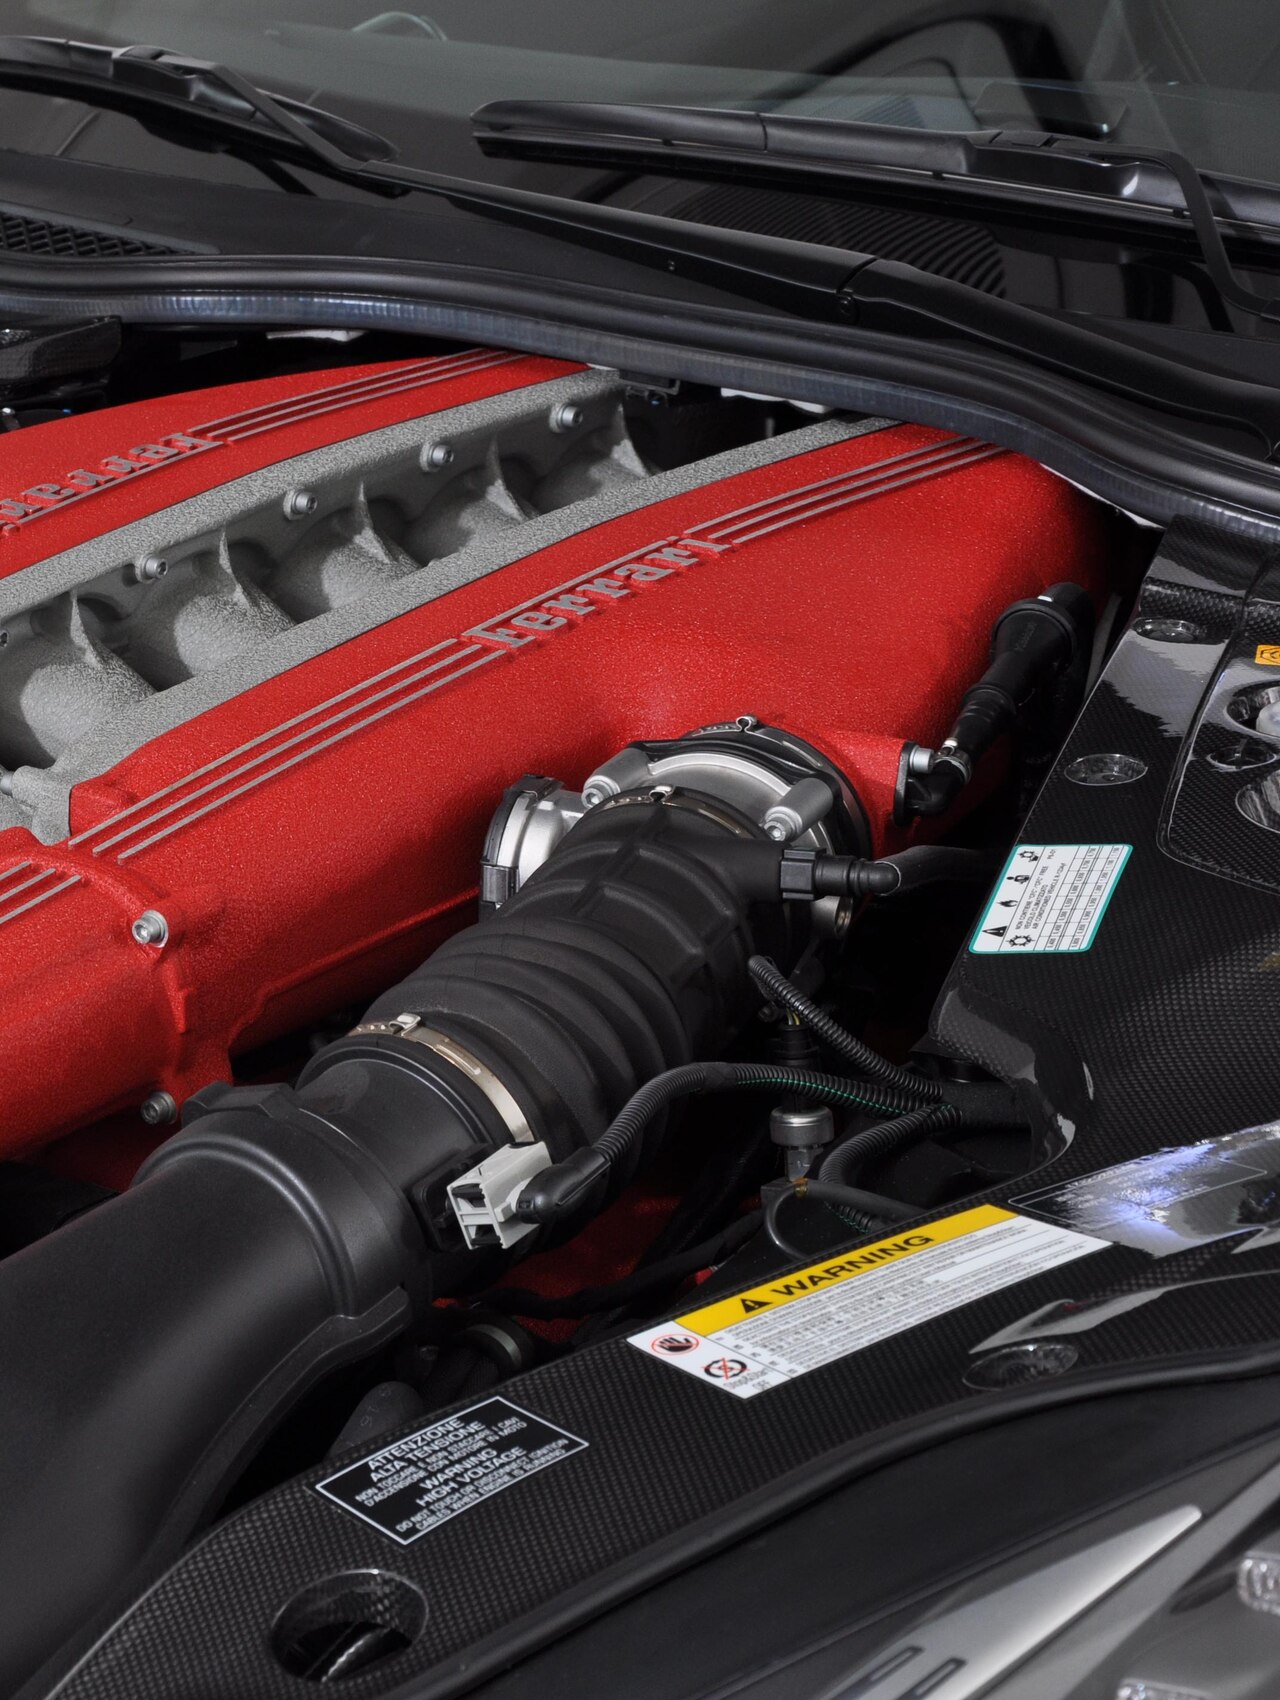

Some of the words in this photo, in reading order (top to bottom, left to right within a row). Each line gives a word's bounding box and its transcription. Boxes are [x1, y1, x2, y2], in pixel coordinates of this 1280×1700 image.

[461, 536, 733, 649] Ferrari
[772, 1235, 934, 1296] WARNING
[354, 1487, 379, 1500] NON
[376, 1466, 418, 1488] TOCCARE
[425, 1450, 448, 1463] NON
[447, 1429, 491, 1452] STACCARE
[497, 1416, 519, 1428] CAVI
[363, 1470, 429, 1505] D'ACCENSIONE
[427, 1459, 450, 1471] CON
[449, 1440, 487, 1460] MOTORE
[498, 1421, 528, 1436] MOTO
[367, 1418, 464, 1469] ATTENZIONE
[370, 1459, 408, 1481] ALTA
[404, 1420, 485, 1462] TENSIONE
[419, 1448, 498, 1490] WARNING
[415, 1481, 459, 1505] HIGH
[456, 1446, 526, 1484] VOLTAGE
[415, 1509, 452, 1529] CABLES
[450, 1492, 480, 1509] WHEN
[478, 1475, 512, 1493] ENGINE
[395, 1520, 414, 1531] DO
[409, 1509, 432, 1522] NOT
[428, 1492, 463, 1511] TOUCH
[459, 1485, 476, 1494] OR
